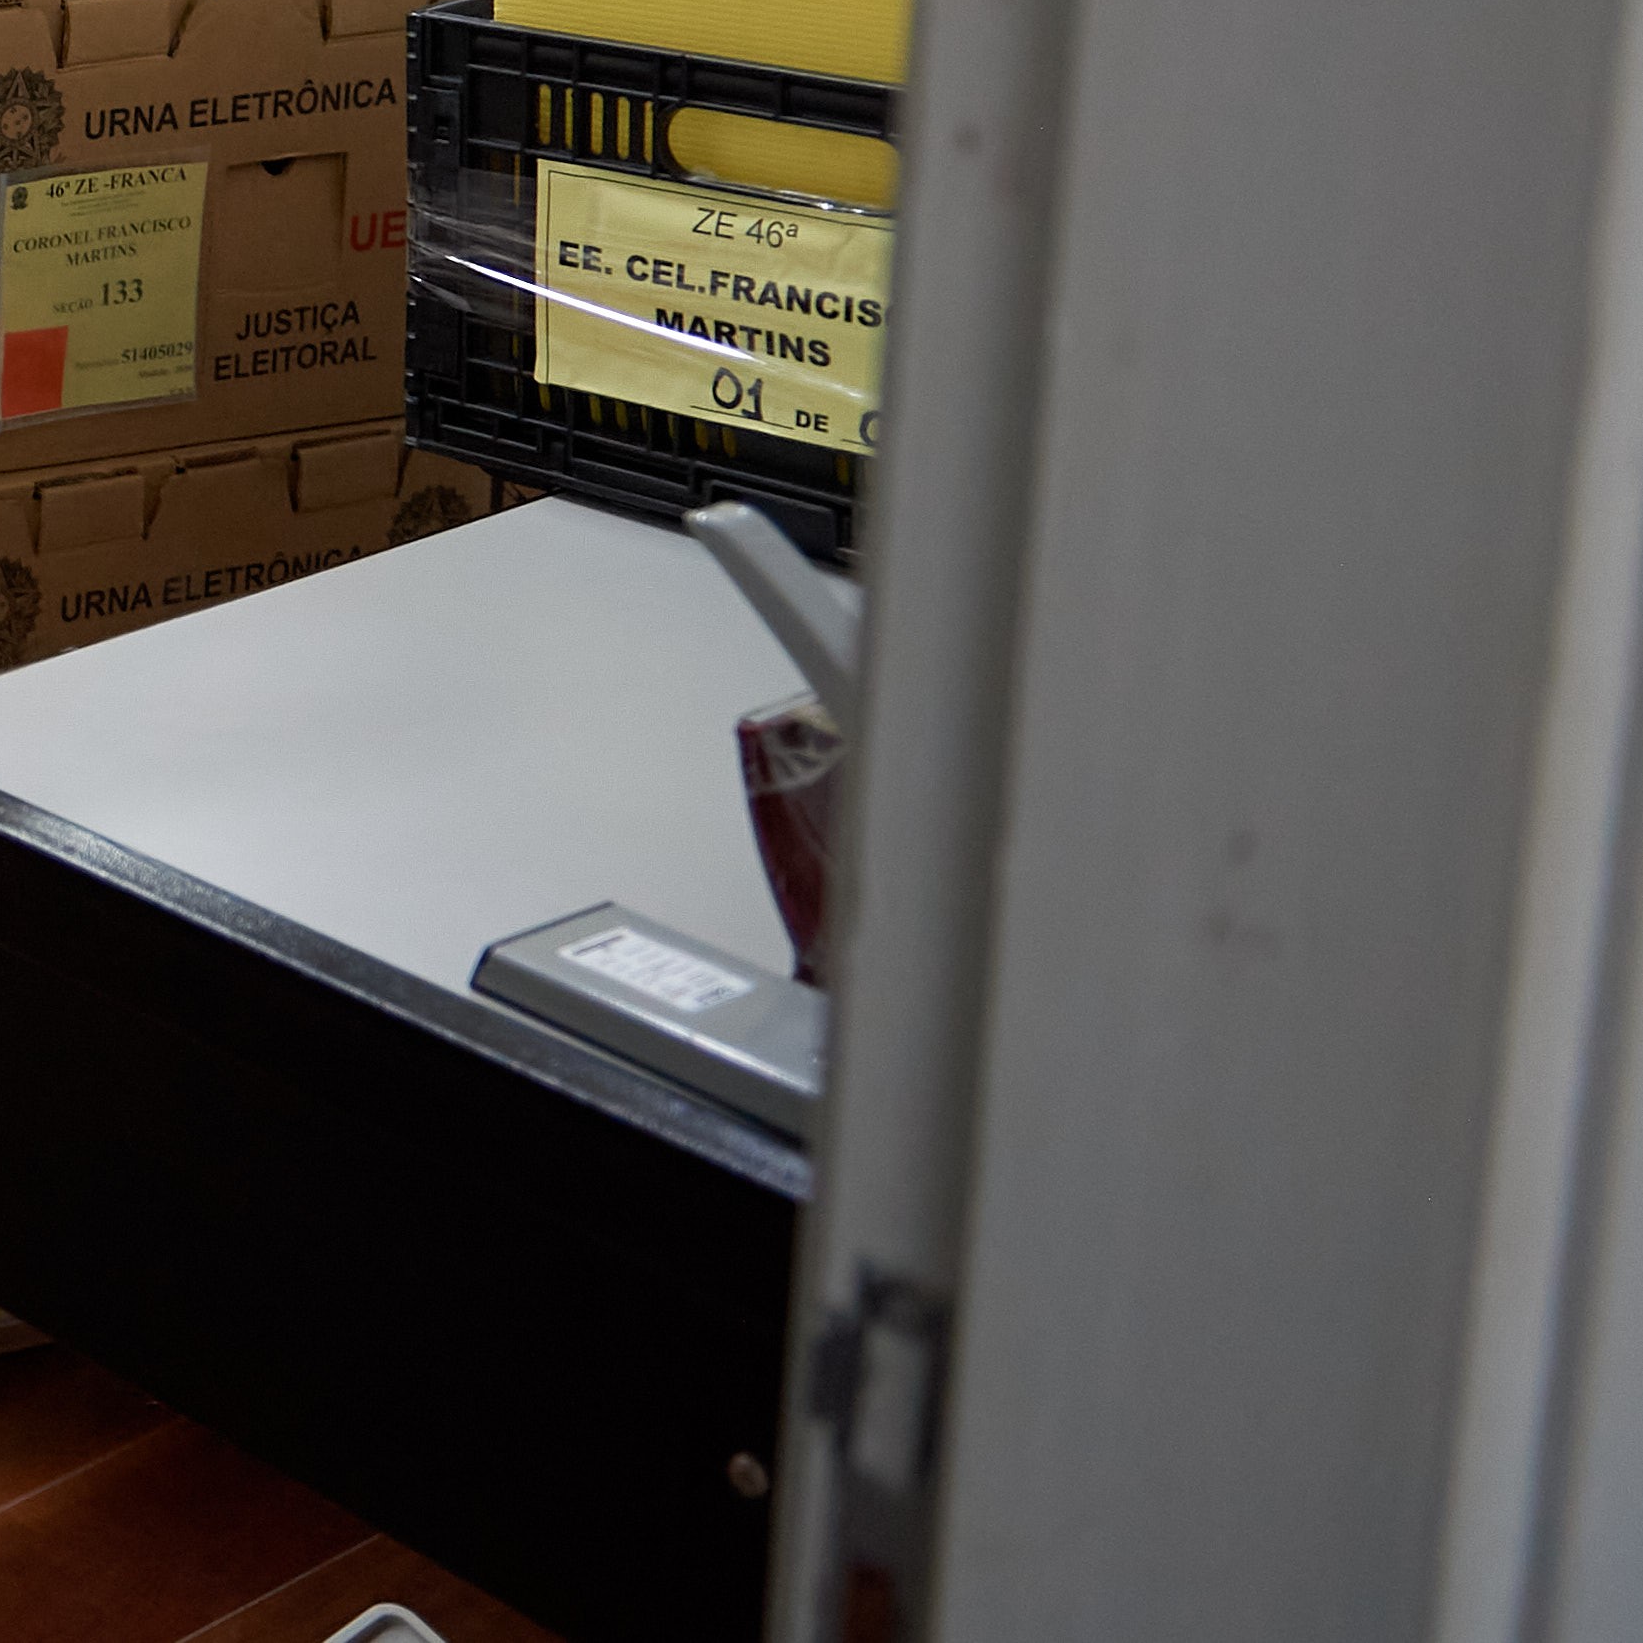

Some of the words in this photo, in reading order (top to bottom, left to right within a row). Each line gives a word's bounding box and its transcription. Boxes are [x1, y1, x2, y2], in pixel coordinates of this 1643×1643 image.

[85, 102, 179, 140] URNA
[189, 77, 397, 128] ELETRÔNICA
[74, 177, 98, 195] ZE
[13, 230, 94, 254] CORONEL
[98, 215, 191, 241] FRANCISCO
[349, 210, 407, 252] UE
[692, 207, 738, 240] ZE
[745, 218, 799, 248] 46ª
[66, 243, 138, 267] MARTINS
[101, 278, 144, 306] 133
[558, 240, 613, 275] EE.
[625, 254, 886, 328] CEL.FRANCIS
[235, 300, 360, 341] JUSTIÇA
[655, 308, 832, 368] MARTINS
[214, 336, 377, 382] ELEITORAL
[795, 409, 830, 434] DE
[60, 582, 153, 623] URNA
